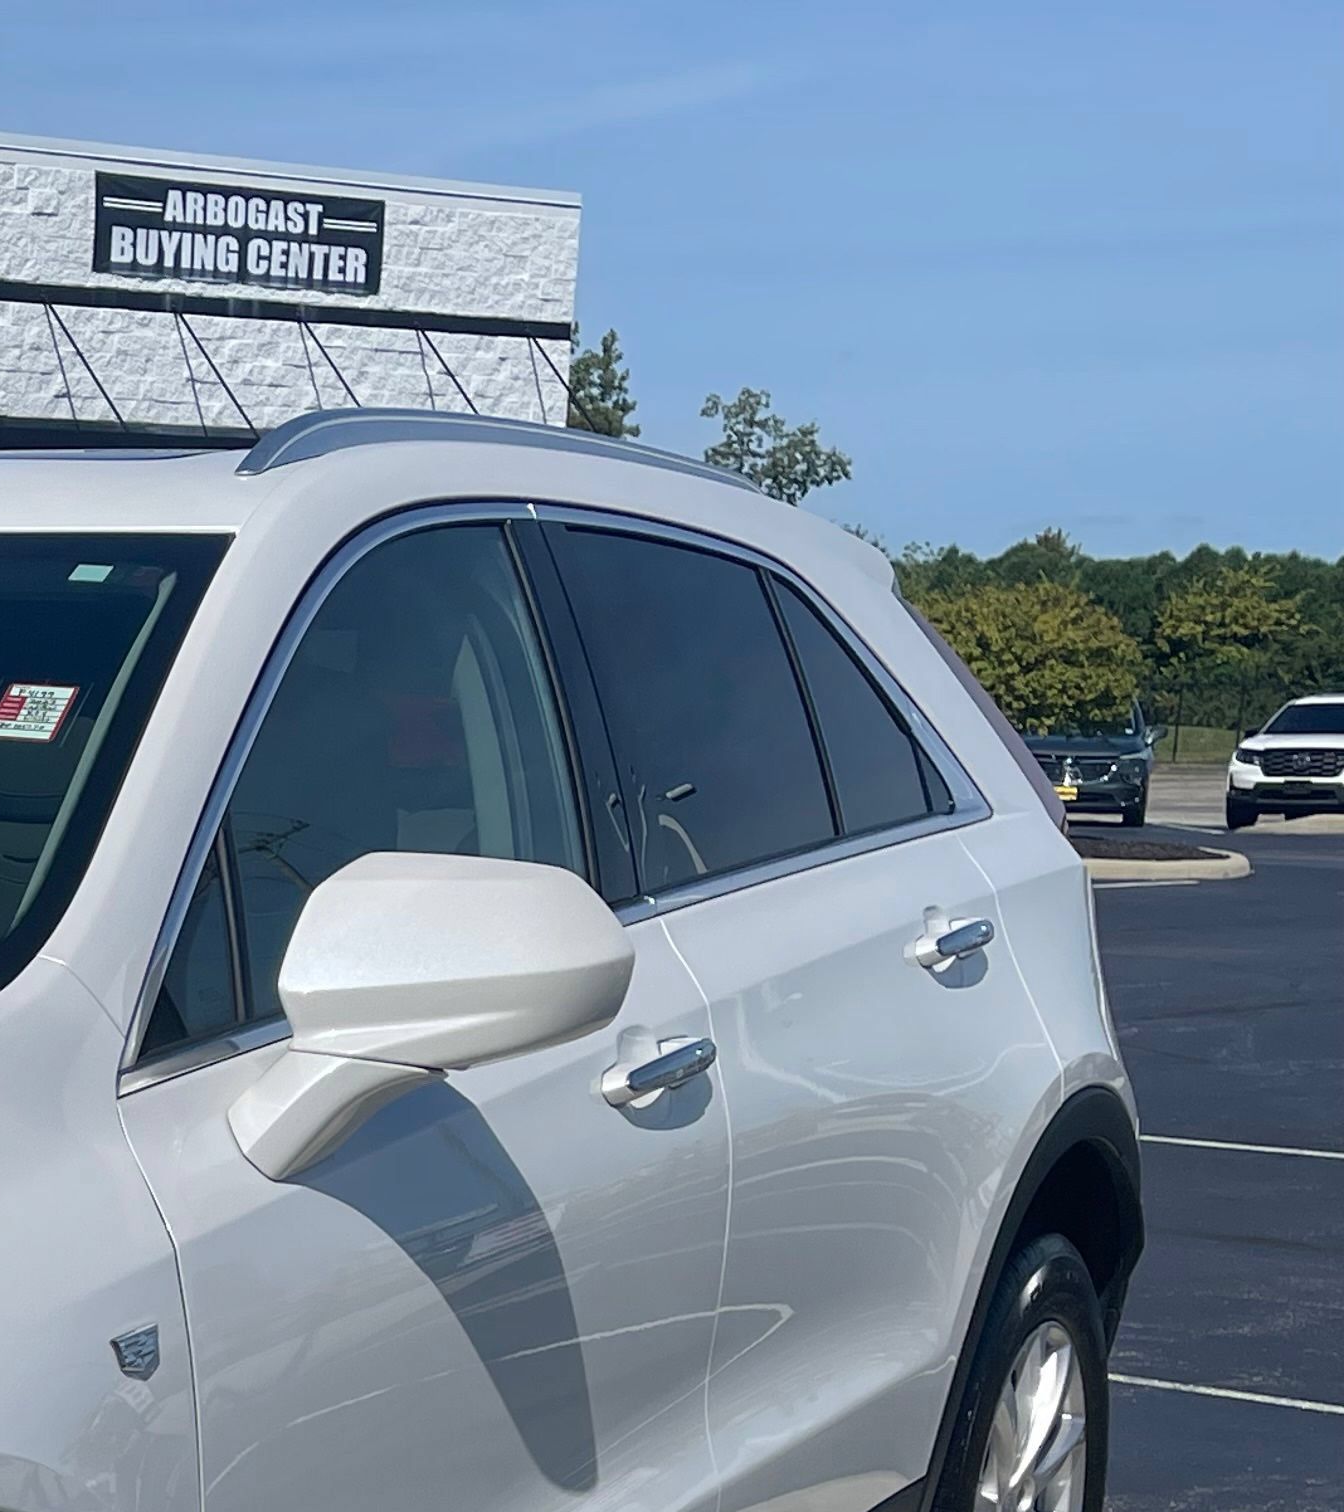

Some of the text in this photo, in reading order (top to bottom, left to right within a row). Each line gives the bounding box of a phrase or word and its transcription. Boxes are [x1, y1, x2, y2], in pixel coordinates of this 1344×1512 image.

[163, 189, 324, 235] ARBOGAST
[110, 226, 367, 283] BUYING CENTER
